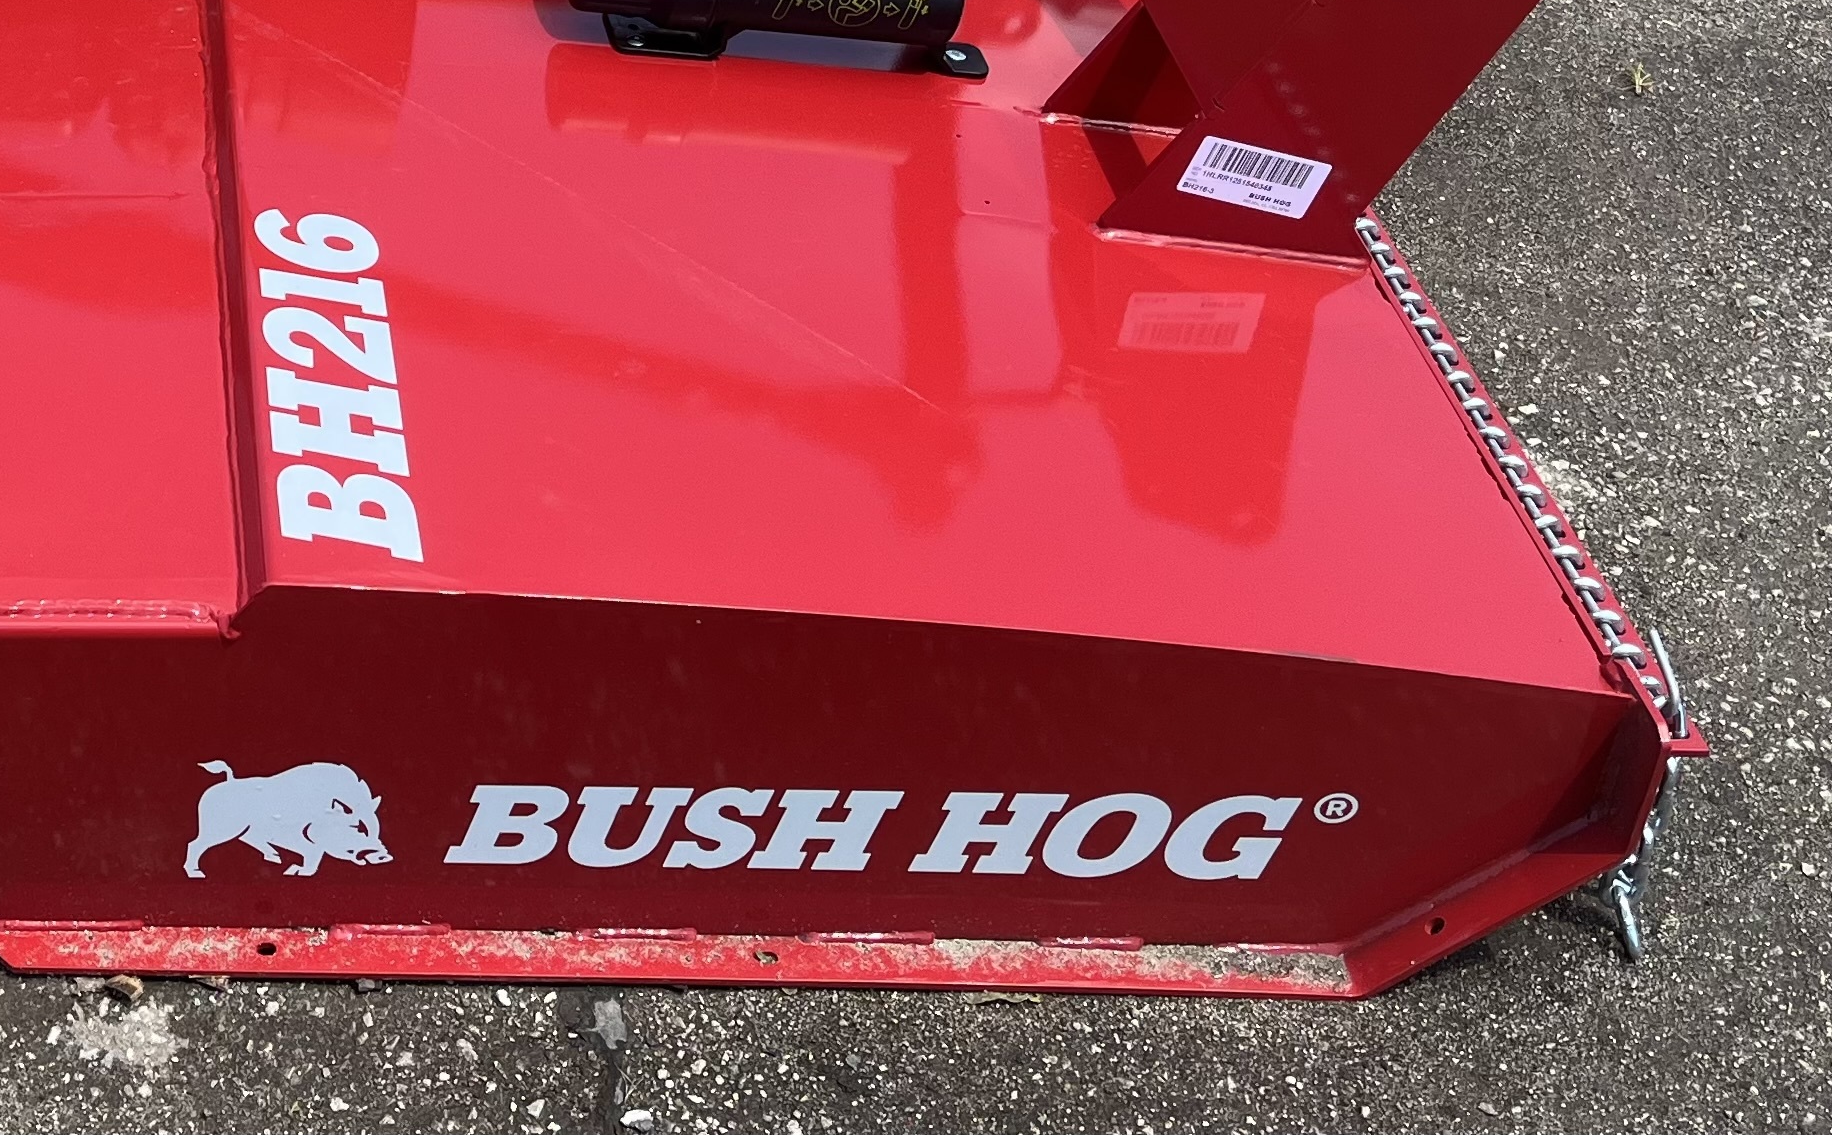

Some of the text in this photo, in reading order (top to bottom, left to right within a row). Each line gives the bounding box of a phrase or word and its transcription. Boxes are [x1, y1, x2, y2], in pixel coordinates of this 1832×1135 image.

[253, 208, 425, 564] BH216
[443, 784, 905, 872] BUSH
[908, 792, 1303, 881] HOG
